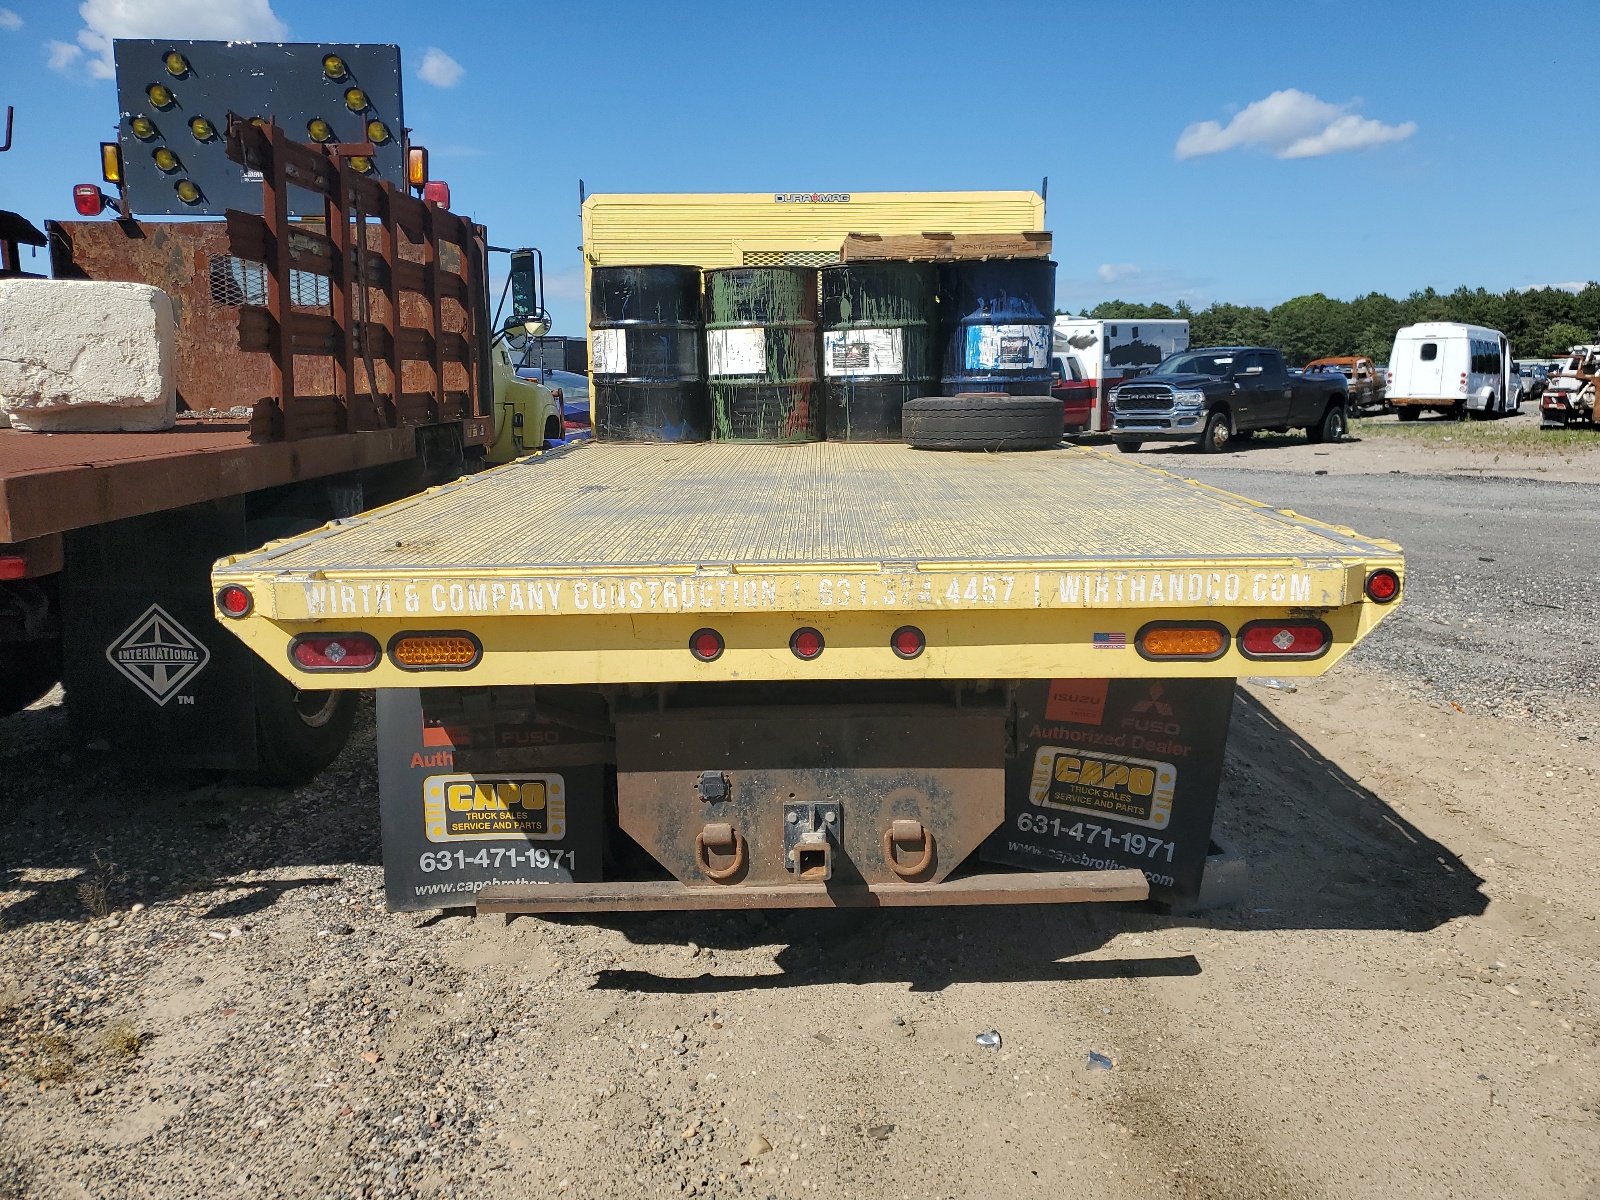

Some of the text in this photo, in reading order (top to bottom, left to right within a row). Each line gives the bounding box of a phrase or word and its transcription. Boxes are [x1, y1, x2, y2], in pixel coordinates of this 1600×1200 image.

[304, 583, 393, 614] WIRTH
[404, 583, 421, 612] &
[431, 581, 562, 613] COMPANY
[573, 578, 777, 610] CONSTRUCTION
[1058, 572, 1312, 604] WIRTHANDCO.COM
[118, 647, 199, 660] INTERNATIONAL
[177, 695, 195, 705] TM
[1053, 692, 1100, 705] ISUZU
[1121, 717, 1181, 736] FUSO
[502, 731, 560, 743] FUSO
[1029, 724, 1192, 757] Authorized Dealer
[1055, 757, 1155, 796] CAPO
[447, 783, 546, 812] CAPO
[1054, 792, 1145, 815] SERVICE AND PARTS
[1070, 785, 1132, 803] TRUCK SALES
[451, 821, 542, 831] SERVICE AND PARTS
[466, 812, 528, 821] TRUCK SALES
[1017, 812, 1176, 863] 631-471-1971
[419, 848, 576, 873] 631-471-1971
